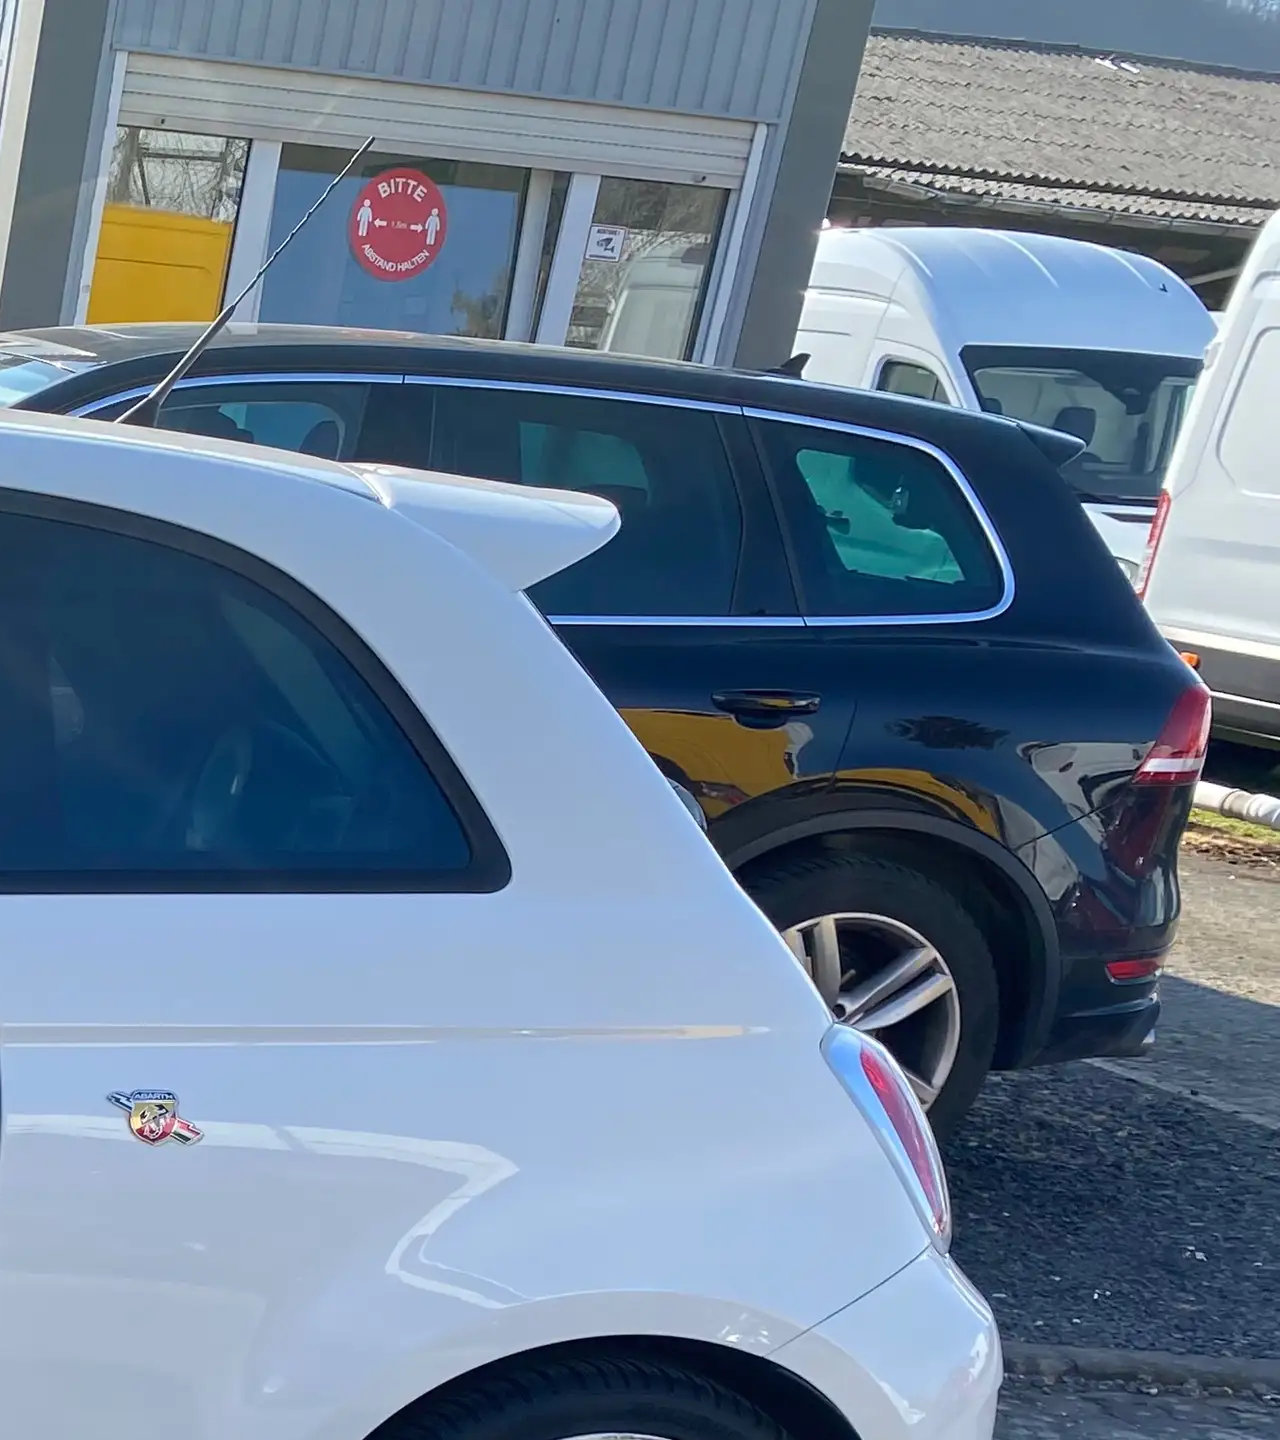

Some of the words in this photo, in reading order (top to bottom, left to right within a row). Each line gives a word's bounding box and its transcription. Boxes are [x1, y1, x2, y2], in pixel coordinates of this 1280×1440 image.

[377, 177, 428, 203] BITTE
[361, 244, 397, 272] ABSTAND
[397, 249, 430, 272] HALTEN
[134, 1092, 174, 1100] ABARTH
